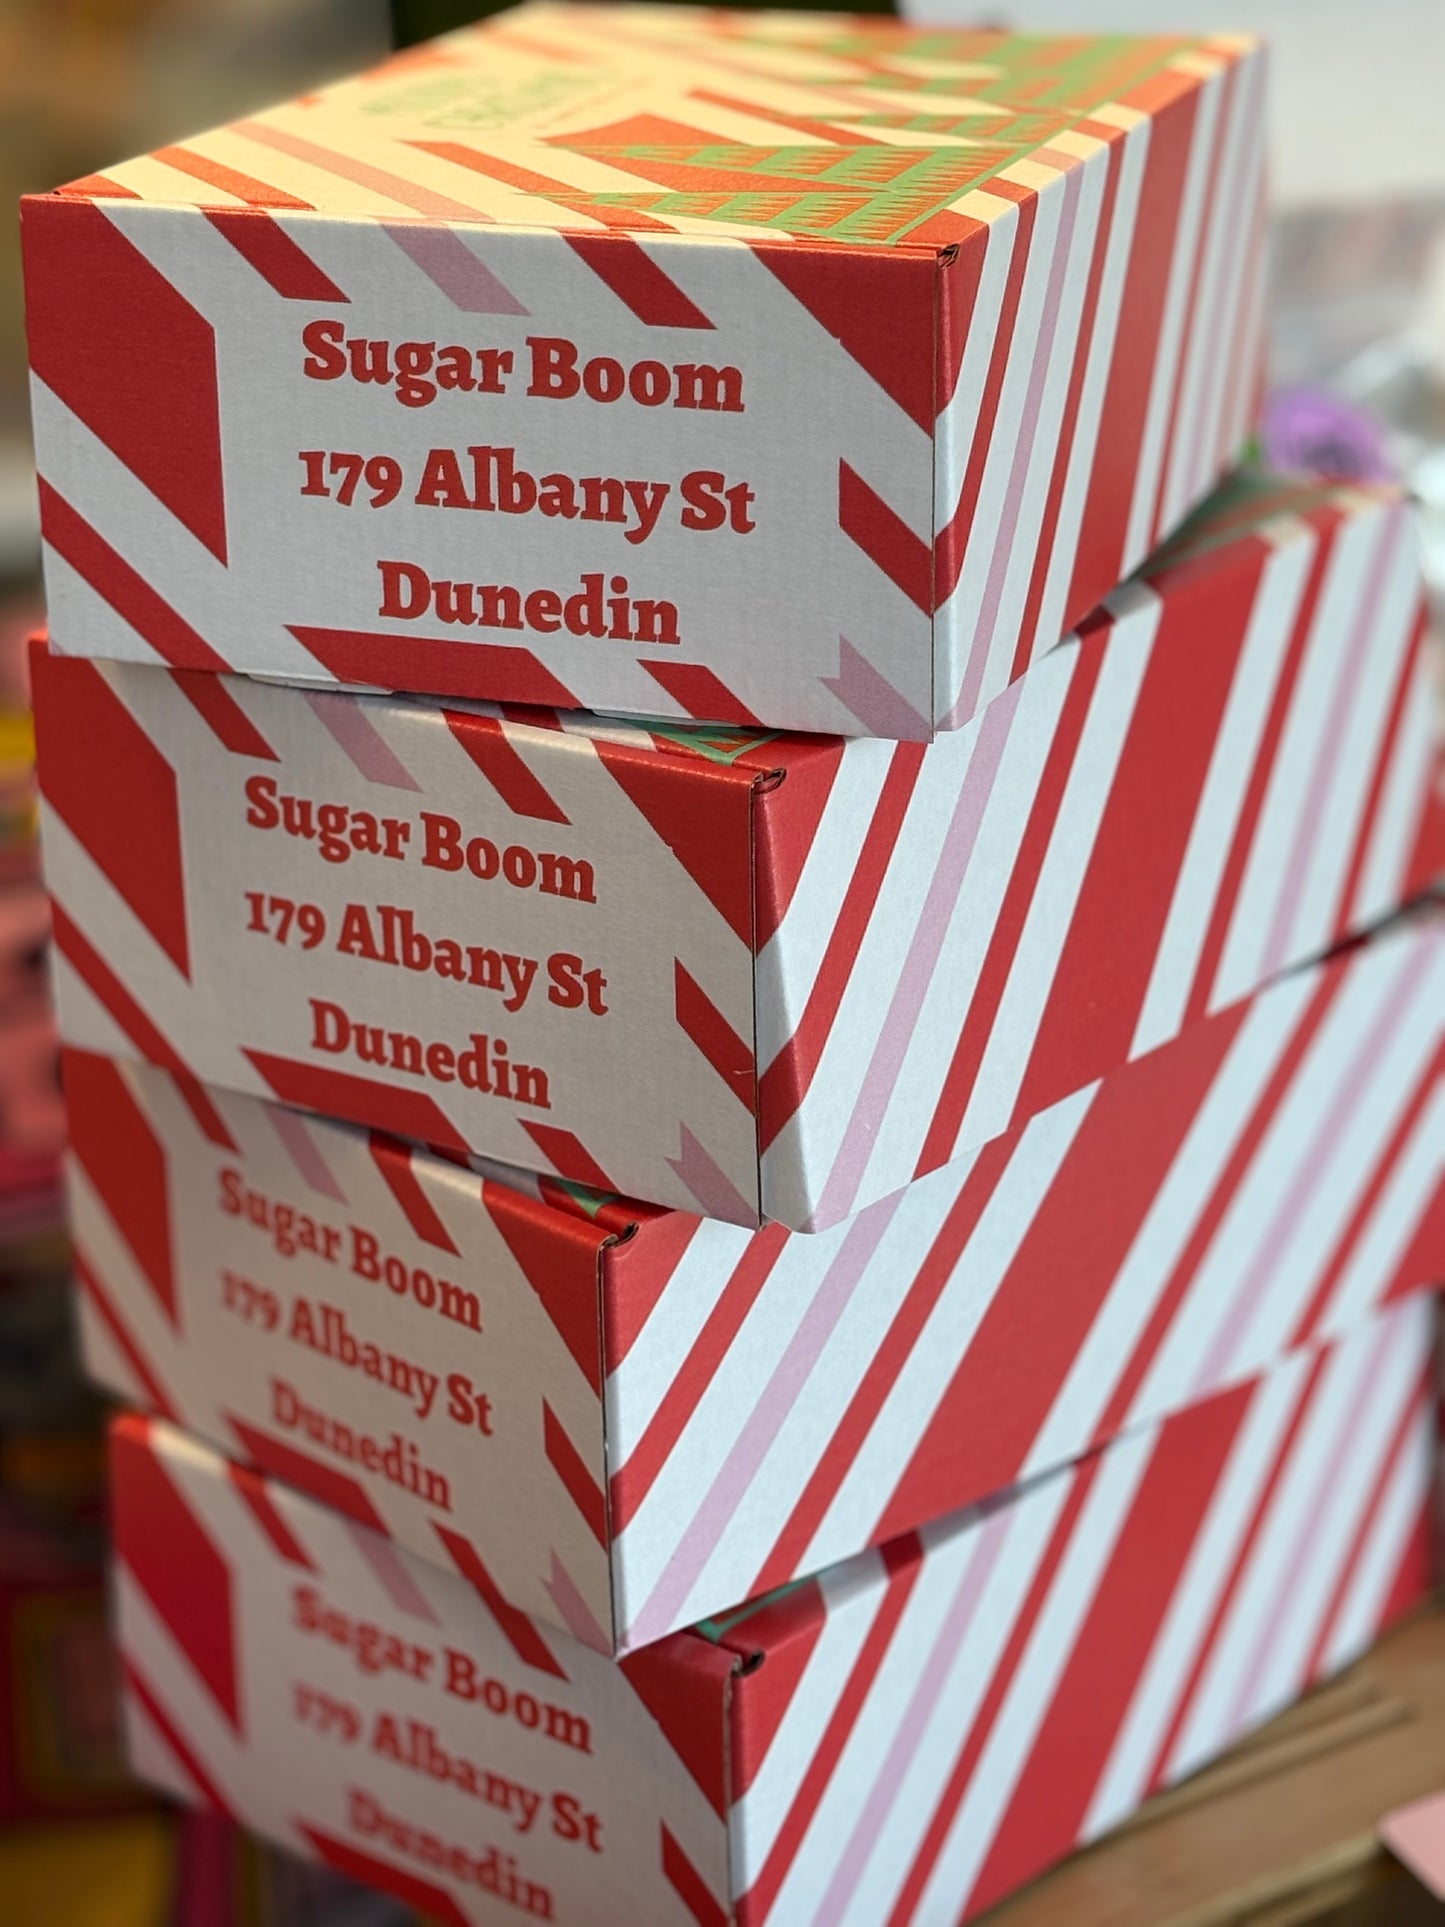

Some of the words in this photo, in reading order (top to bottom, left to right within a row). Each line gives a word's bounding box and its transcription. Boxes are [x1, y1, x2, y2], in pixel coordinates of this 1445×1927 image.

[302, 320, 513, 408] Sugar
[526, 336, 745, 412] Boom
[299, 450, 403, 508] 179
[415, 445, 670, 545] Albany
[680, 471, 756, 534] St
[377, 560, 681, 645] Dunedin
[244, 775, 410, 863] Sugar
[420, 811, 597, 904] Boom
[244, 891, 326, 950] 179
[336, 904, 538, 1013] Albany
[547, 952, 609, 1016] St
[309, 998, 551, 1110] Dunedin
[218, 1166, 343, 1257] Sugar
[350, 1225, 483, 1333] Boom
[220, 1270, 281, 1332] 179
[289, 1297, 440, 1420] Albany
[447, 1373, 494, 1437] St
[271, 1376, 452, 1512] Dunedin
[291, 1585, 433, 1677] Sugar
[443, 1645, 593, 1755] Boom
[372, 1712, 543, 1833] Albany
[551, 1791, 603, 1853] St
[347, 1787, 555, 1921] Dunedin
